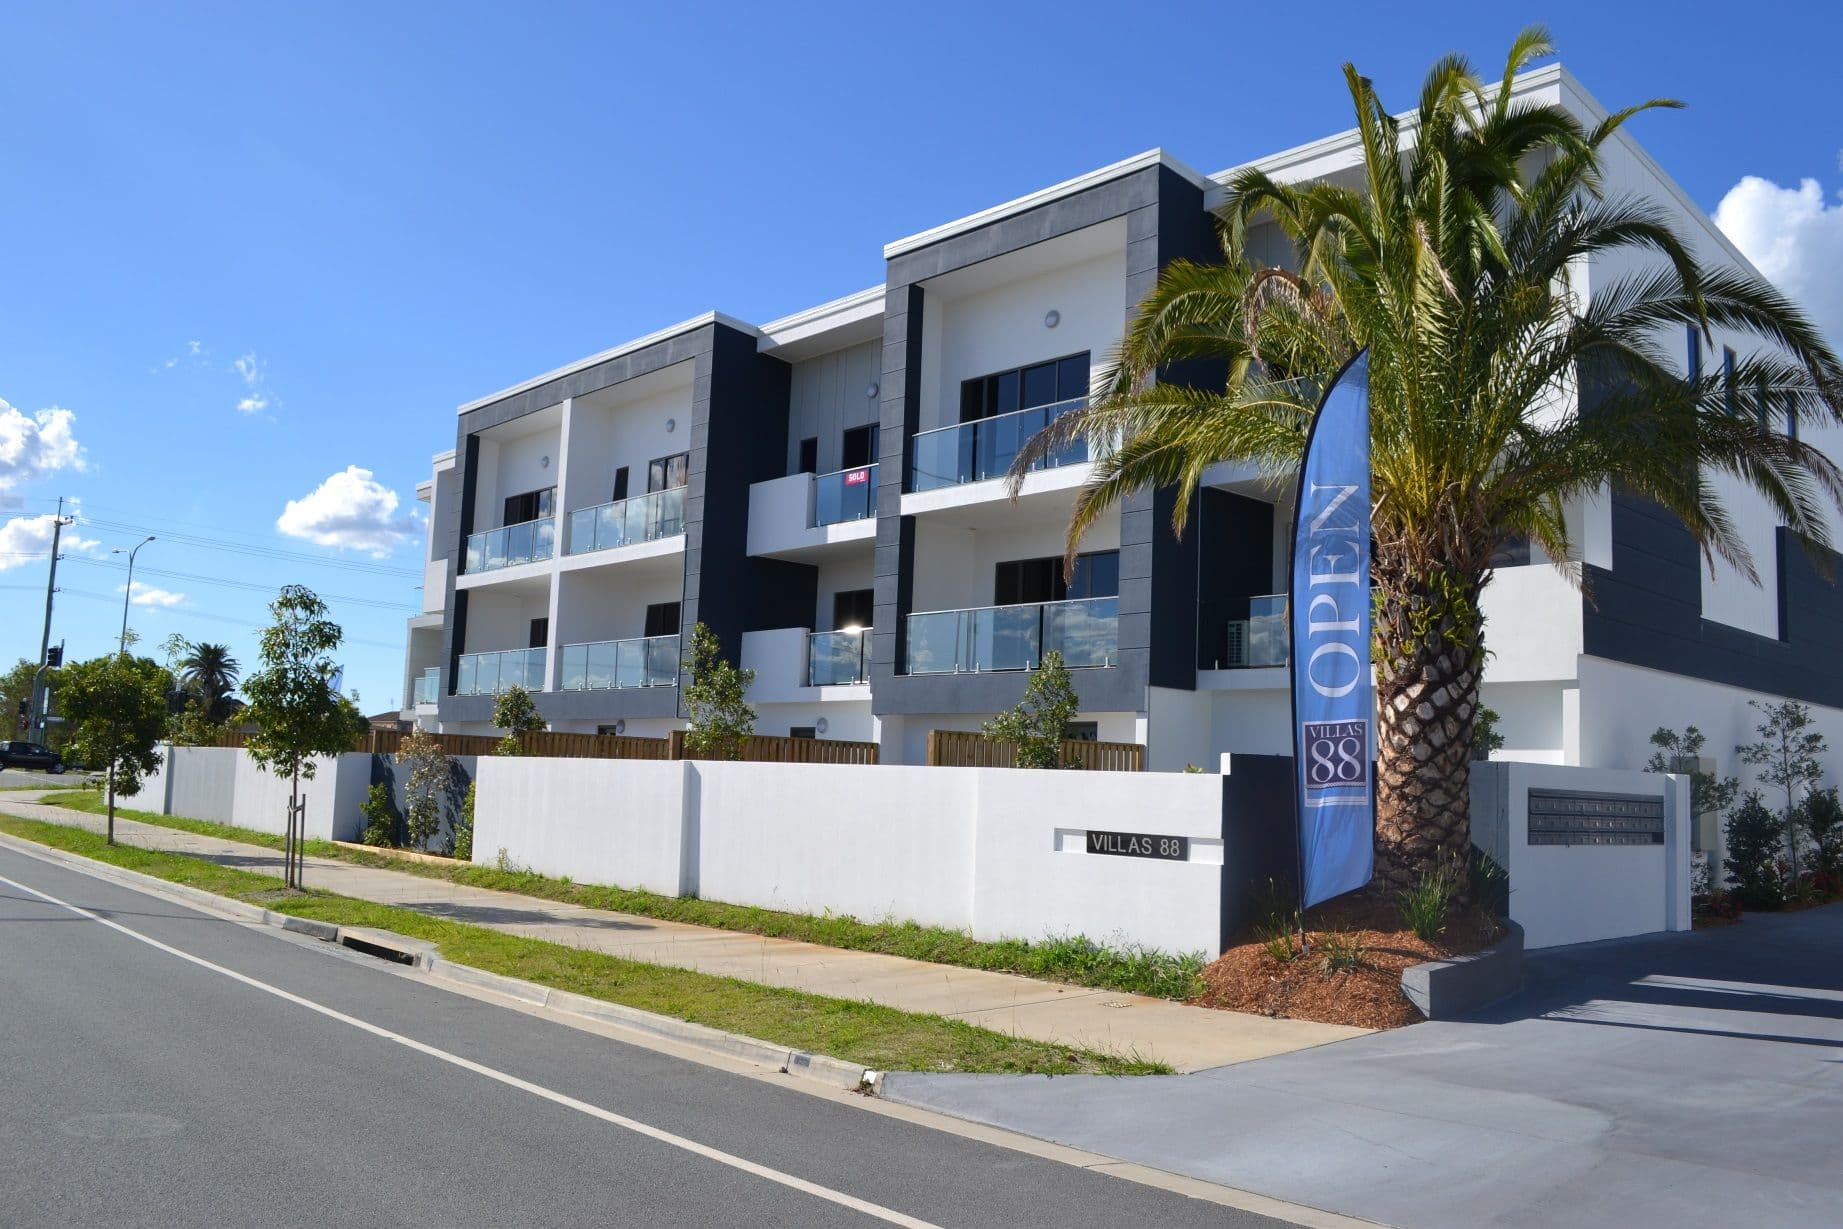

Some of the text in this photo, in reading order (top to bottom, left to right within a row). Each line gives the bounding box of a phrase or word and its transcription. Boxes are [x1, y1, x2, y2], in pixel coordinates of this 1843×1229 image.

[848, 471, 865, 481] SOLD
[1308, 481, 1360, 698] OPEN
[1309, 723, 1363, 738] VILLAS
[1311, 737, 1361, 783] 88
[1092, 833, 1180, 857] VILLAS 88
